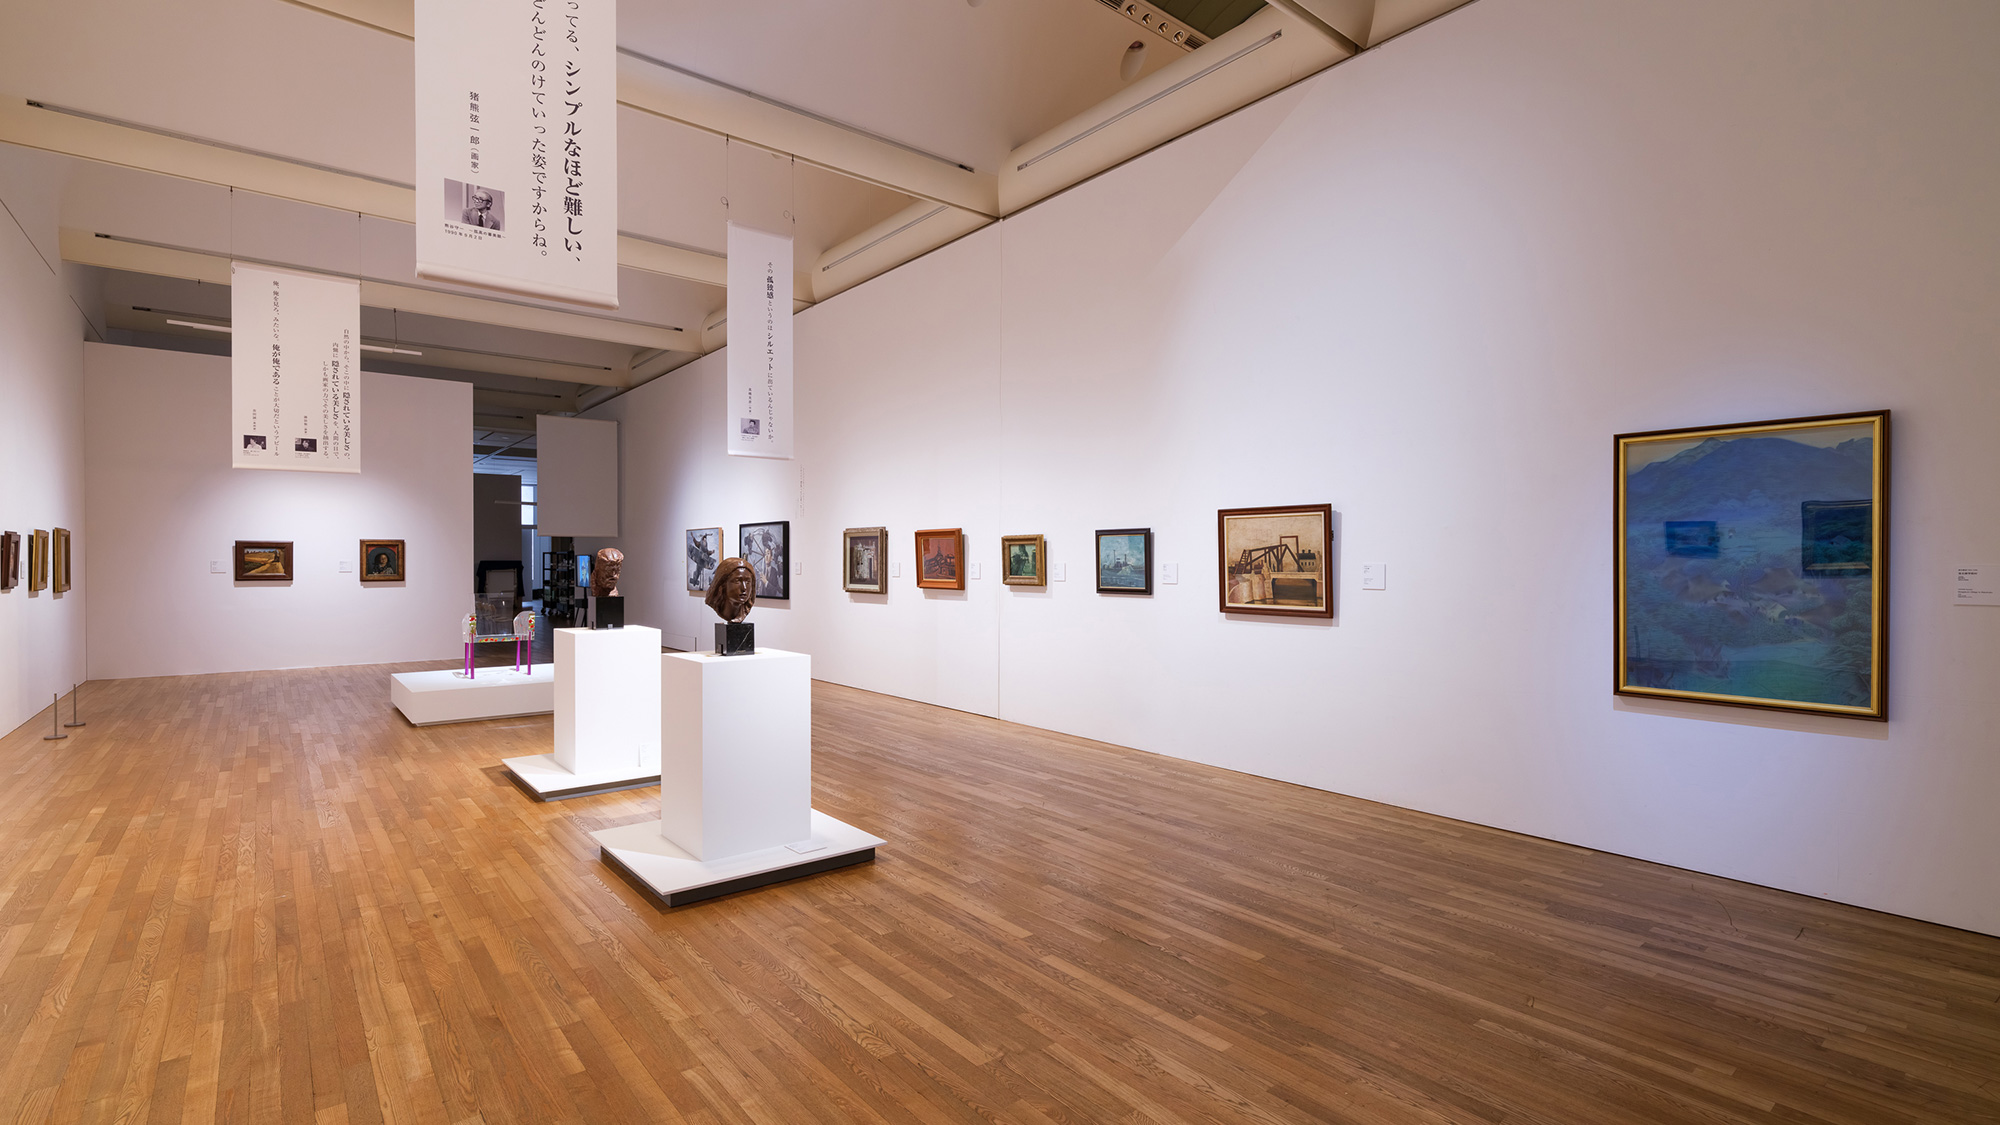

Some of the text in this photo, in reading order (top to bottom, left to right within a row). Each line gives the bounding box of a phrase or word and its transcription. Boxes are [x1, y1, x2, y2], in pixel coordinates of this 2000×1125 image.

[531, 0, 547, 257] どんどんのけていった姿ですからね。
[564, 1, 583, 262] ってる、シンプルなほど難しい、
